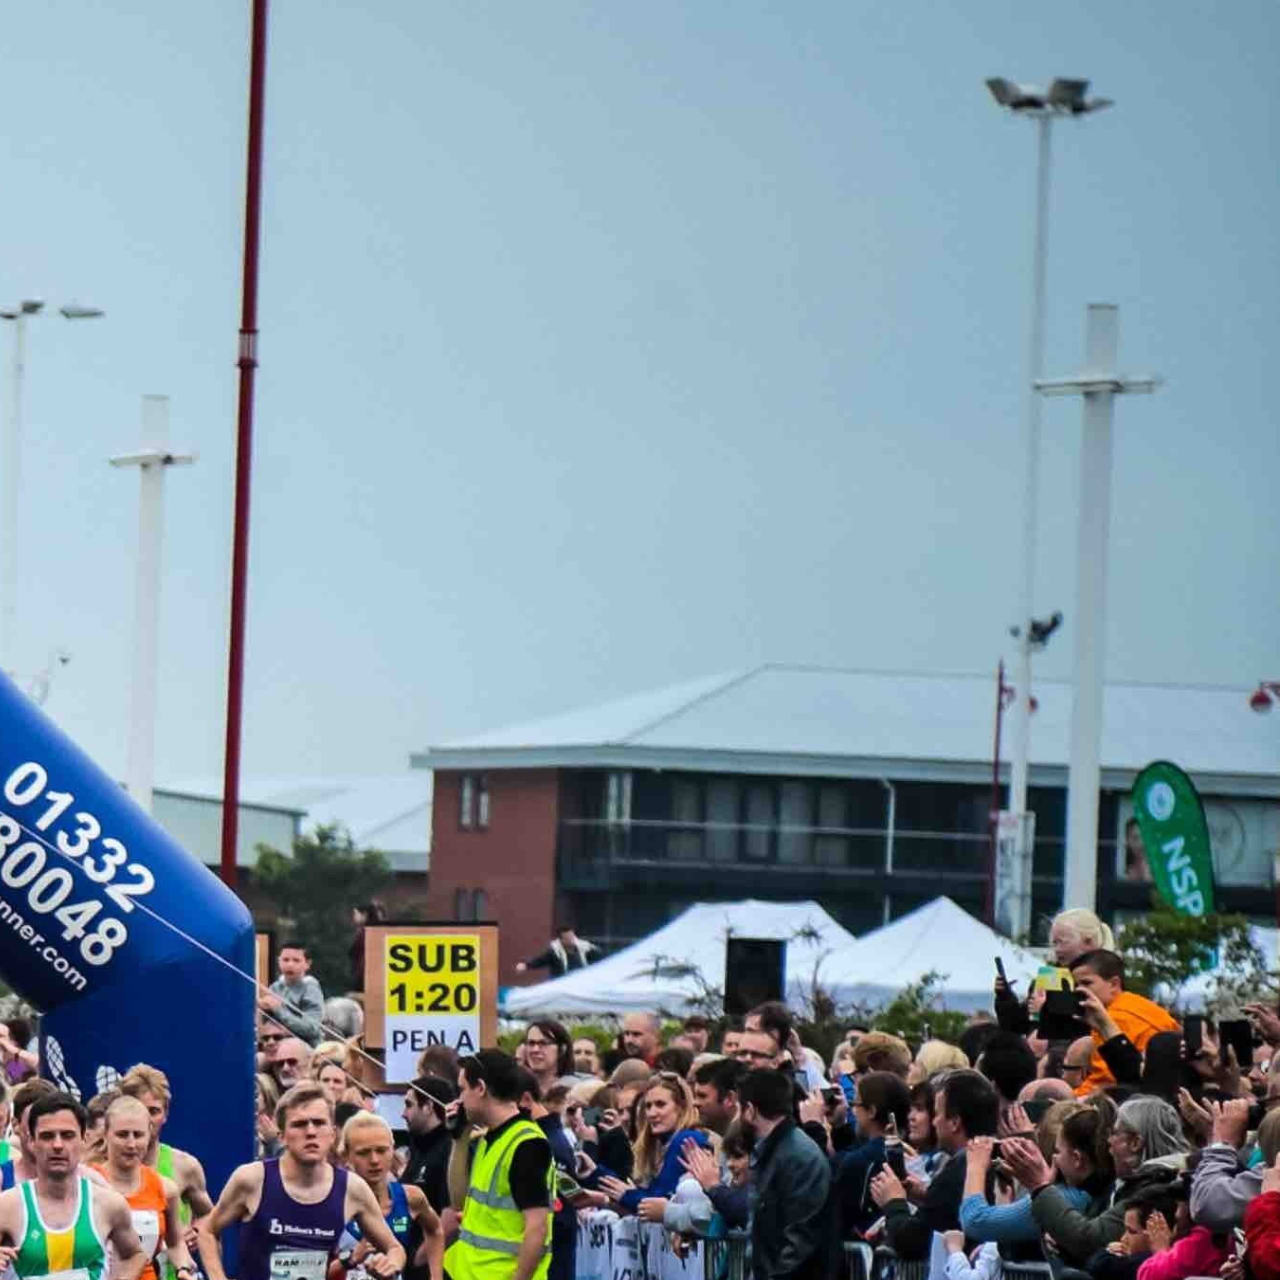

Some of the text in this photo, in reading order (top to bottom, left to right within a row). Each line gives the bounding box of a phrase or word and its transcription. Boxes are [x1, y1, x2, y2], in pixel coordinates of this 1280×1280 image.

[3, 761, 155, 913] 01332
[388, 943, 477, 973] SUB
[390, 982, 477, 1012] 1:20
[392, 1029, 475, 1052] PEN A
